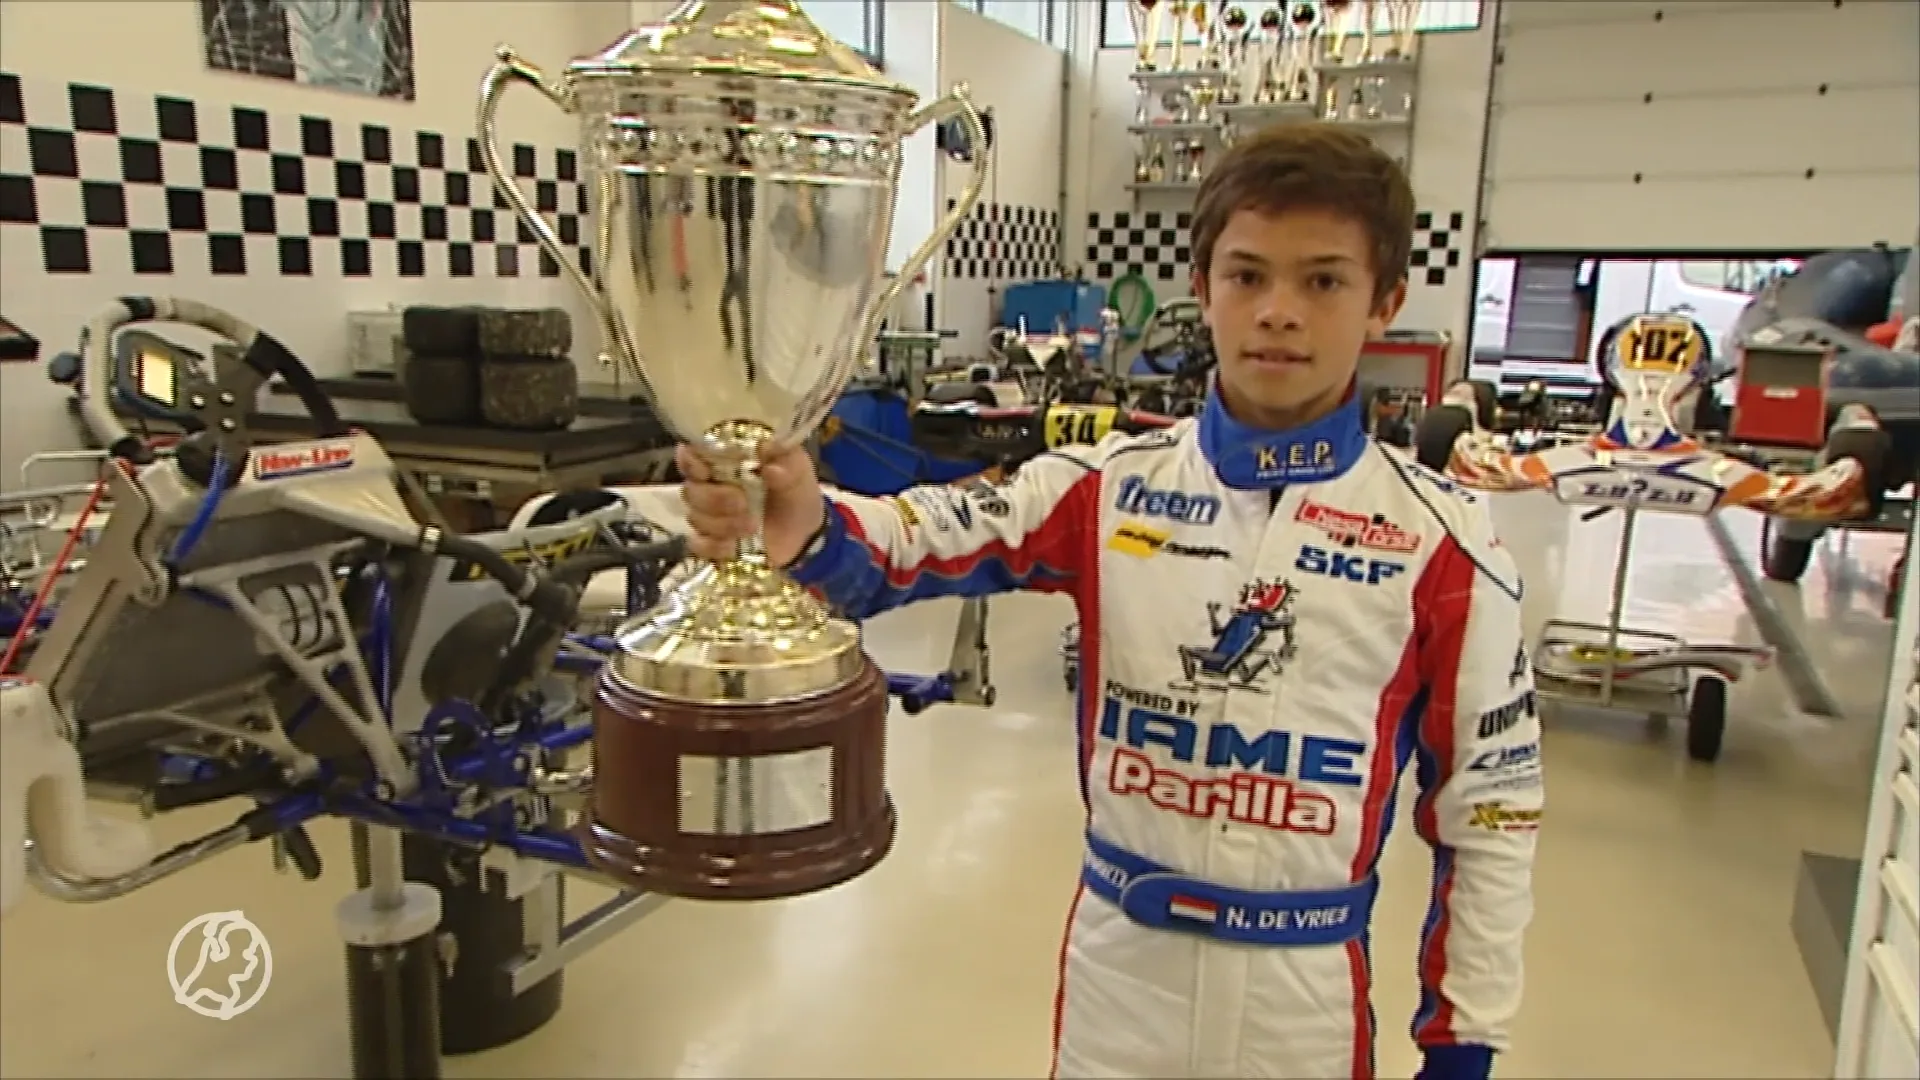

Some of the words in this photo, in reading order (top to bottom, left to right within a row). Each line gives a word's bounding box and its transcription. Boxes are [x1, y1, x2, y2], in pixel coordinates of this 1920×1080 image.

[1055, 411, 1096, 447] 34
[1115, 474, 1222, 527] freem
[1294, 544, 1405, 585] SKF
[1105, 679, 1173, 712] POWERED
[1176, 700, 1200, 716] BY
[1099, 695, 1366, 787] IAME
[1225, 906, 1252, 929] N.
[1257, 910, 1291, 930] DE
[1294, 904, 1350, 930] VRIES
